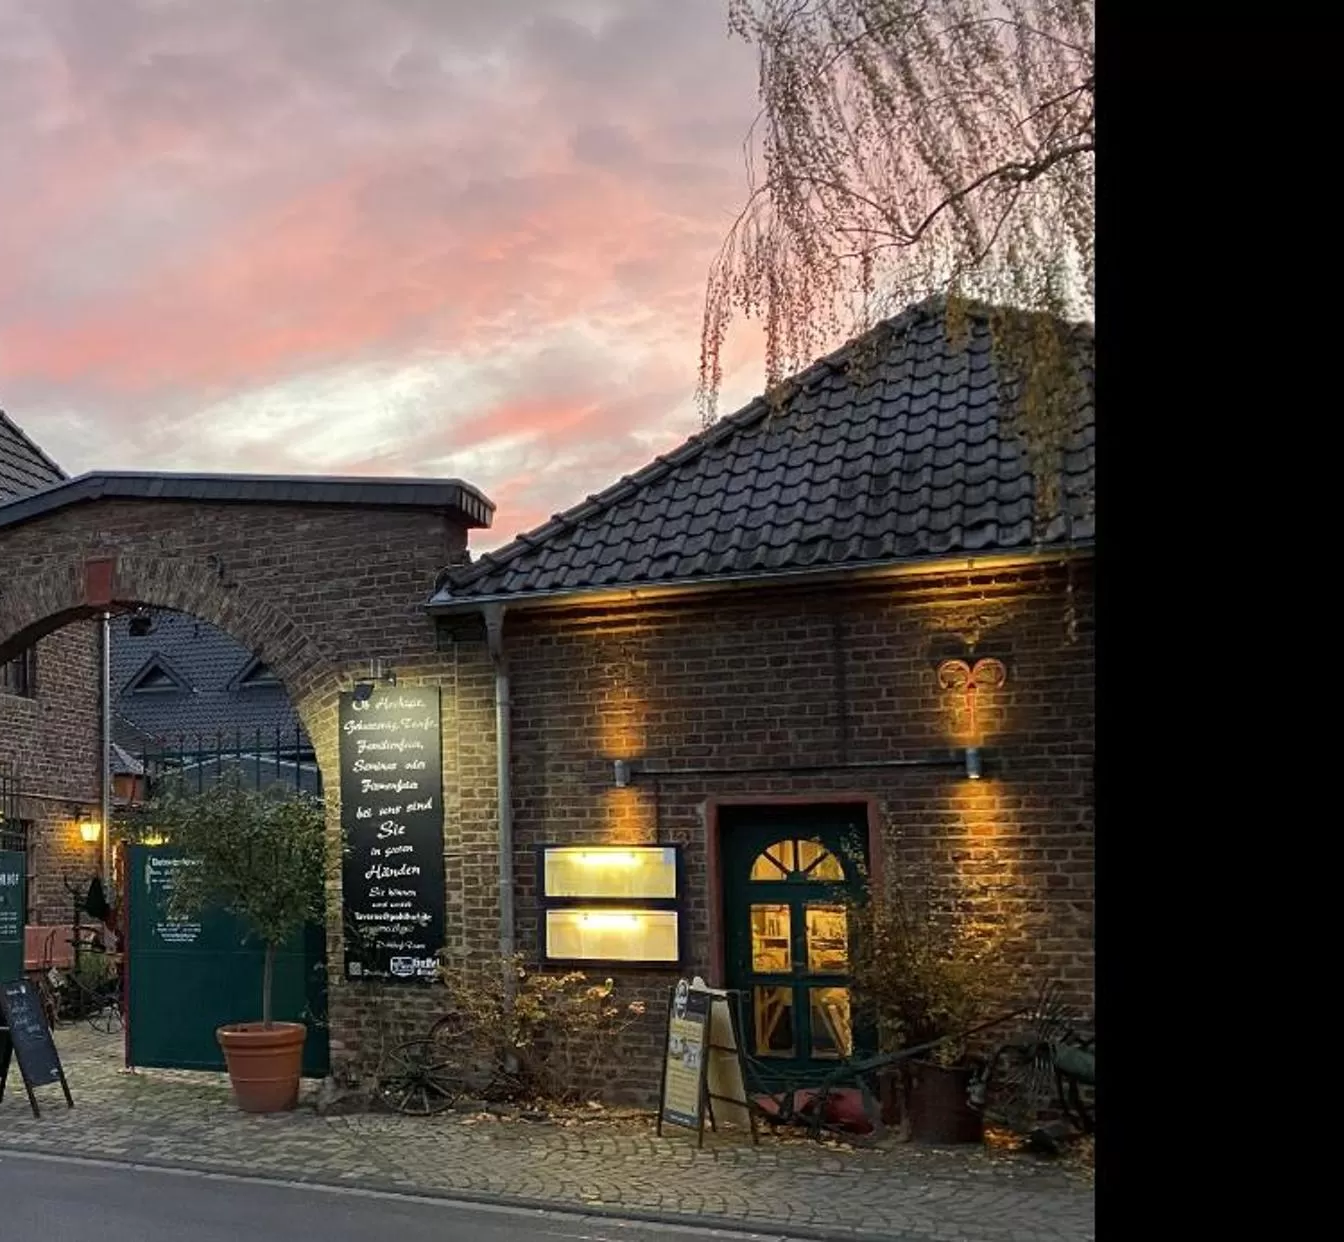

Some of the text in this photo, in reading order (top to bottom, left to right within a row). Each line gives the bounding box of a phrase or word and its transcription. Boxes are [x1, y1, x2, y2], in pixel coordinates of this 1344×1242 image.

[356, 796, 433, 820] bei uns sind
[376, 820, 406, 839] Sie
[364, 863, 421, 880] Händen
